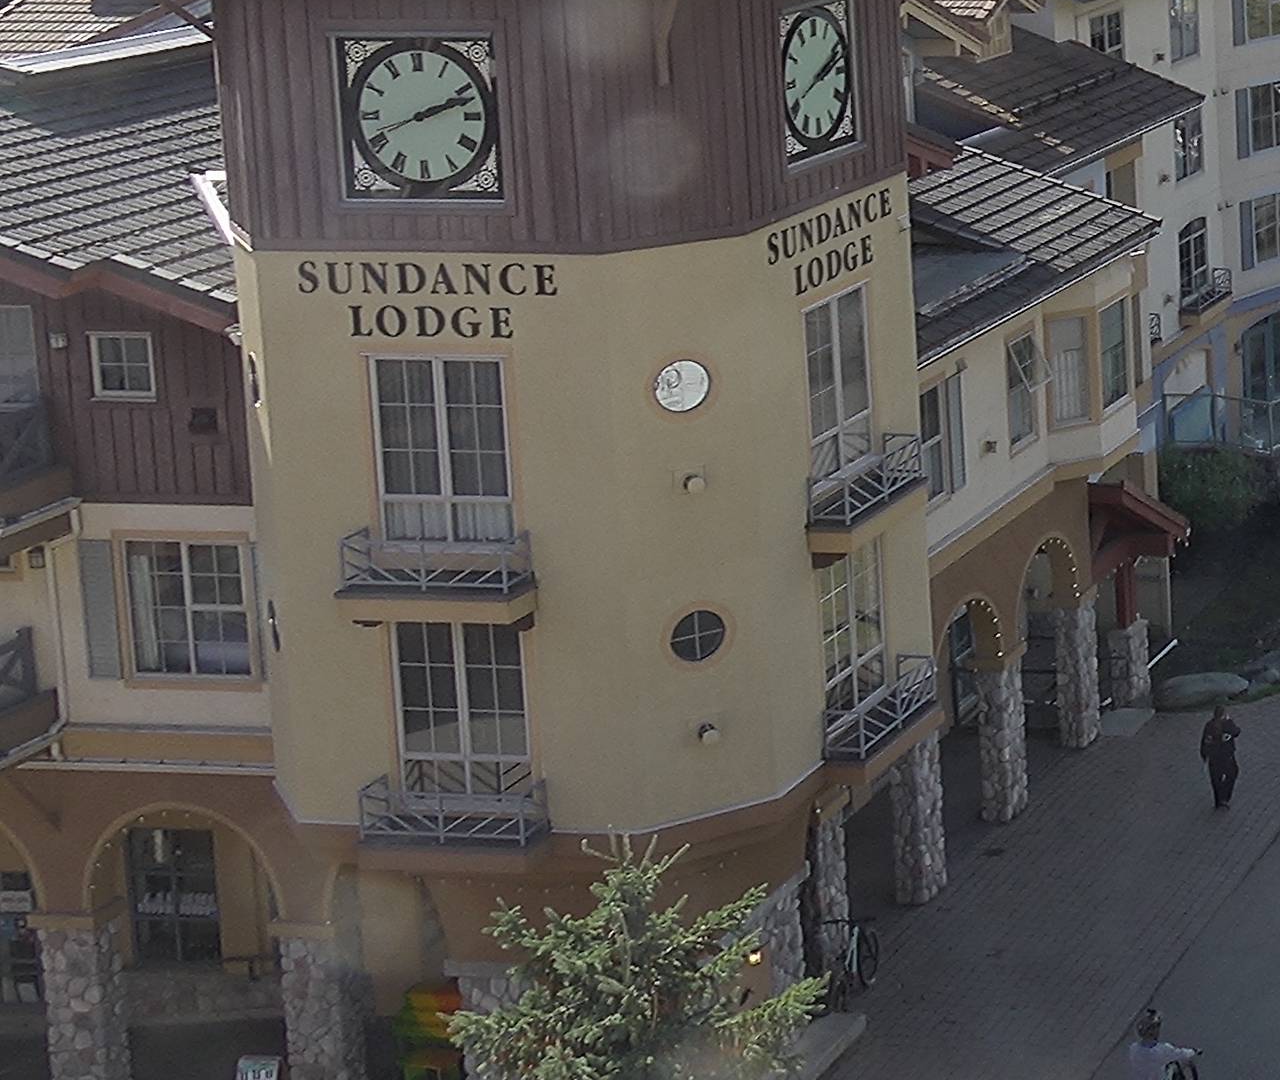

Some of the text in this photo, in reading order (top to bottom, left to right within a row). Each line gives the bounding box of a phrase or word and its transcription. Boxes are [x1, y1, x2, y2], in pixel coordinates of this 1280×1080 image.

[767, 188, 892, 265] SUNDANCE
[298, 261, 558, 296] SUNDANCE
[794, 235, 873, 296] LODGE
[348, 305, 514, 339] LODGE
